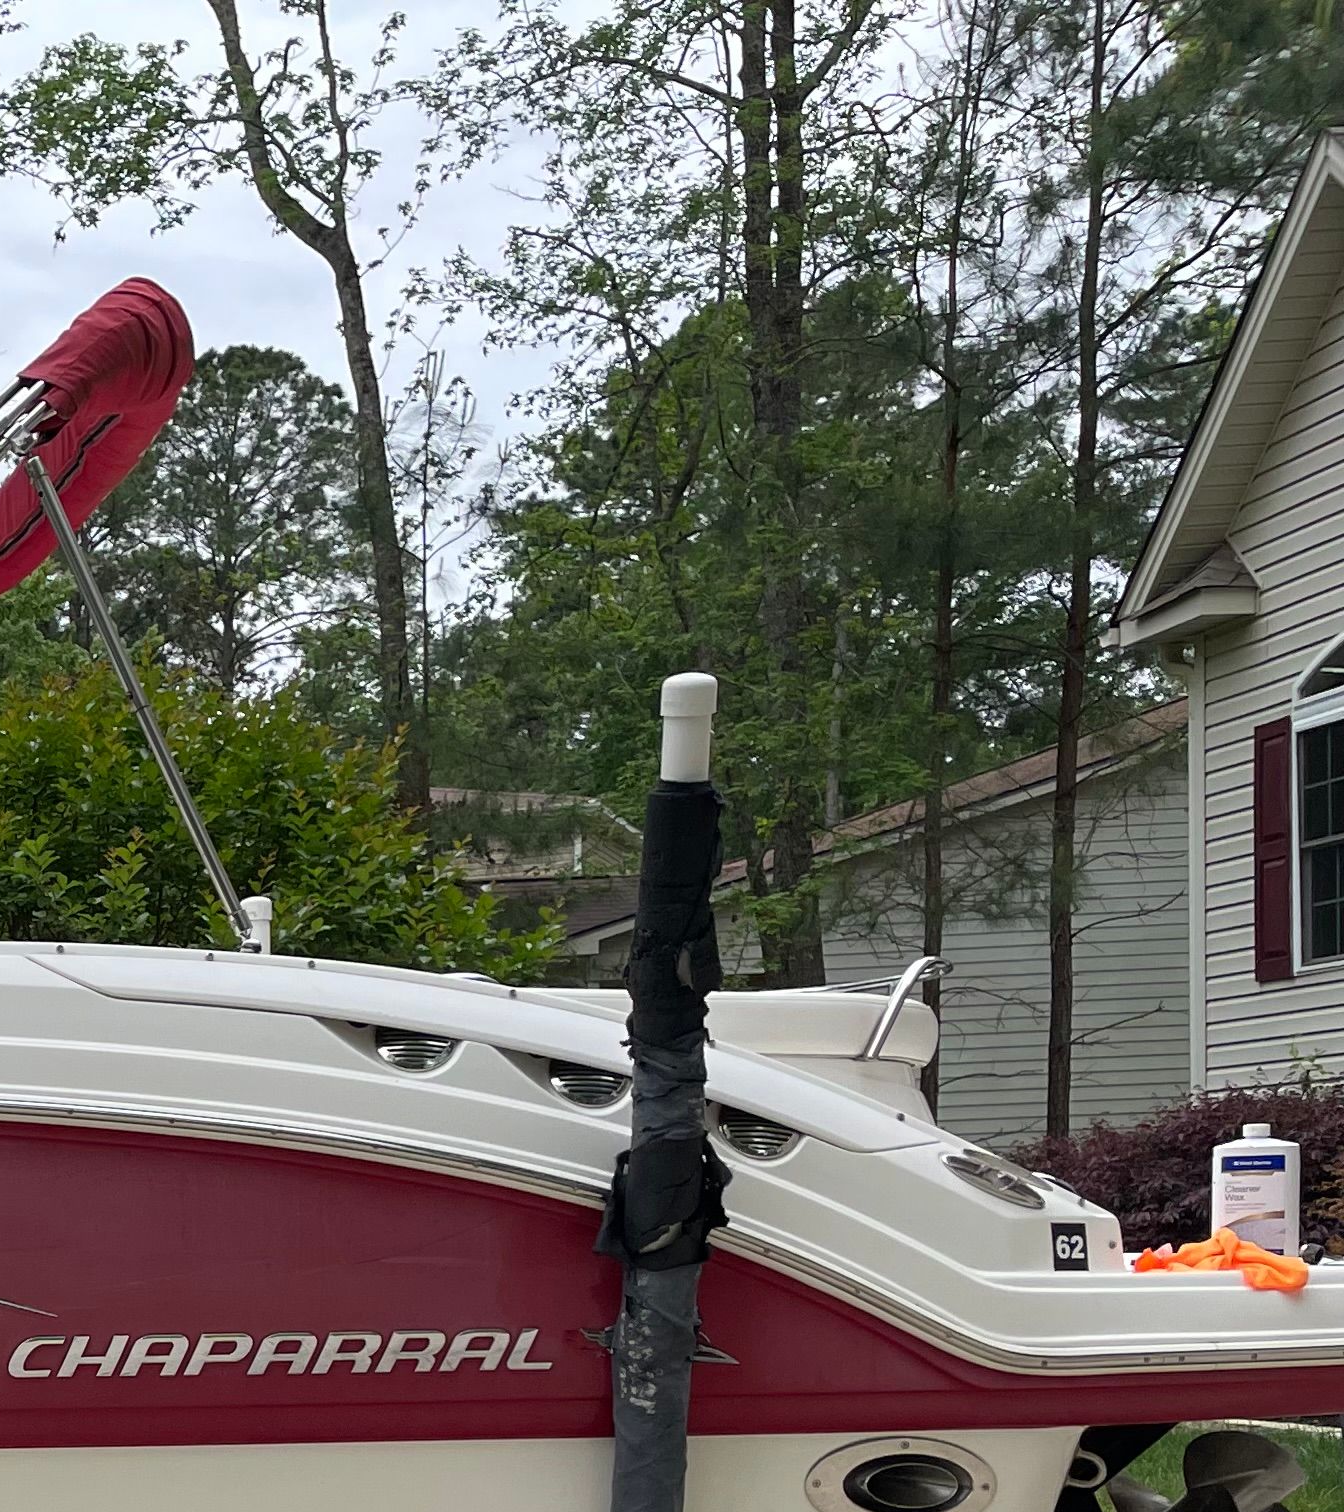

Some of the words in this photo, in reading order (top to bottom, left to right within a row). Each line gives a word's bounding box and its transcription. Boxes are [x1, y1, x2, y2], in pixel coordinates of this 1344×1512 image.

[1224, 1193, 1245, 1202] Wax
[1055, 1235, 1085, 1260] 62
[7, 1327, 553, 1378] CHAPARRAL
